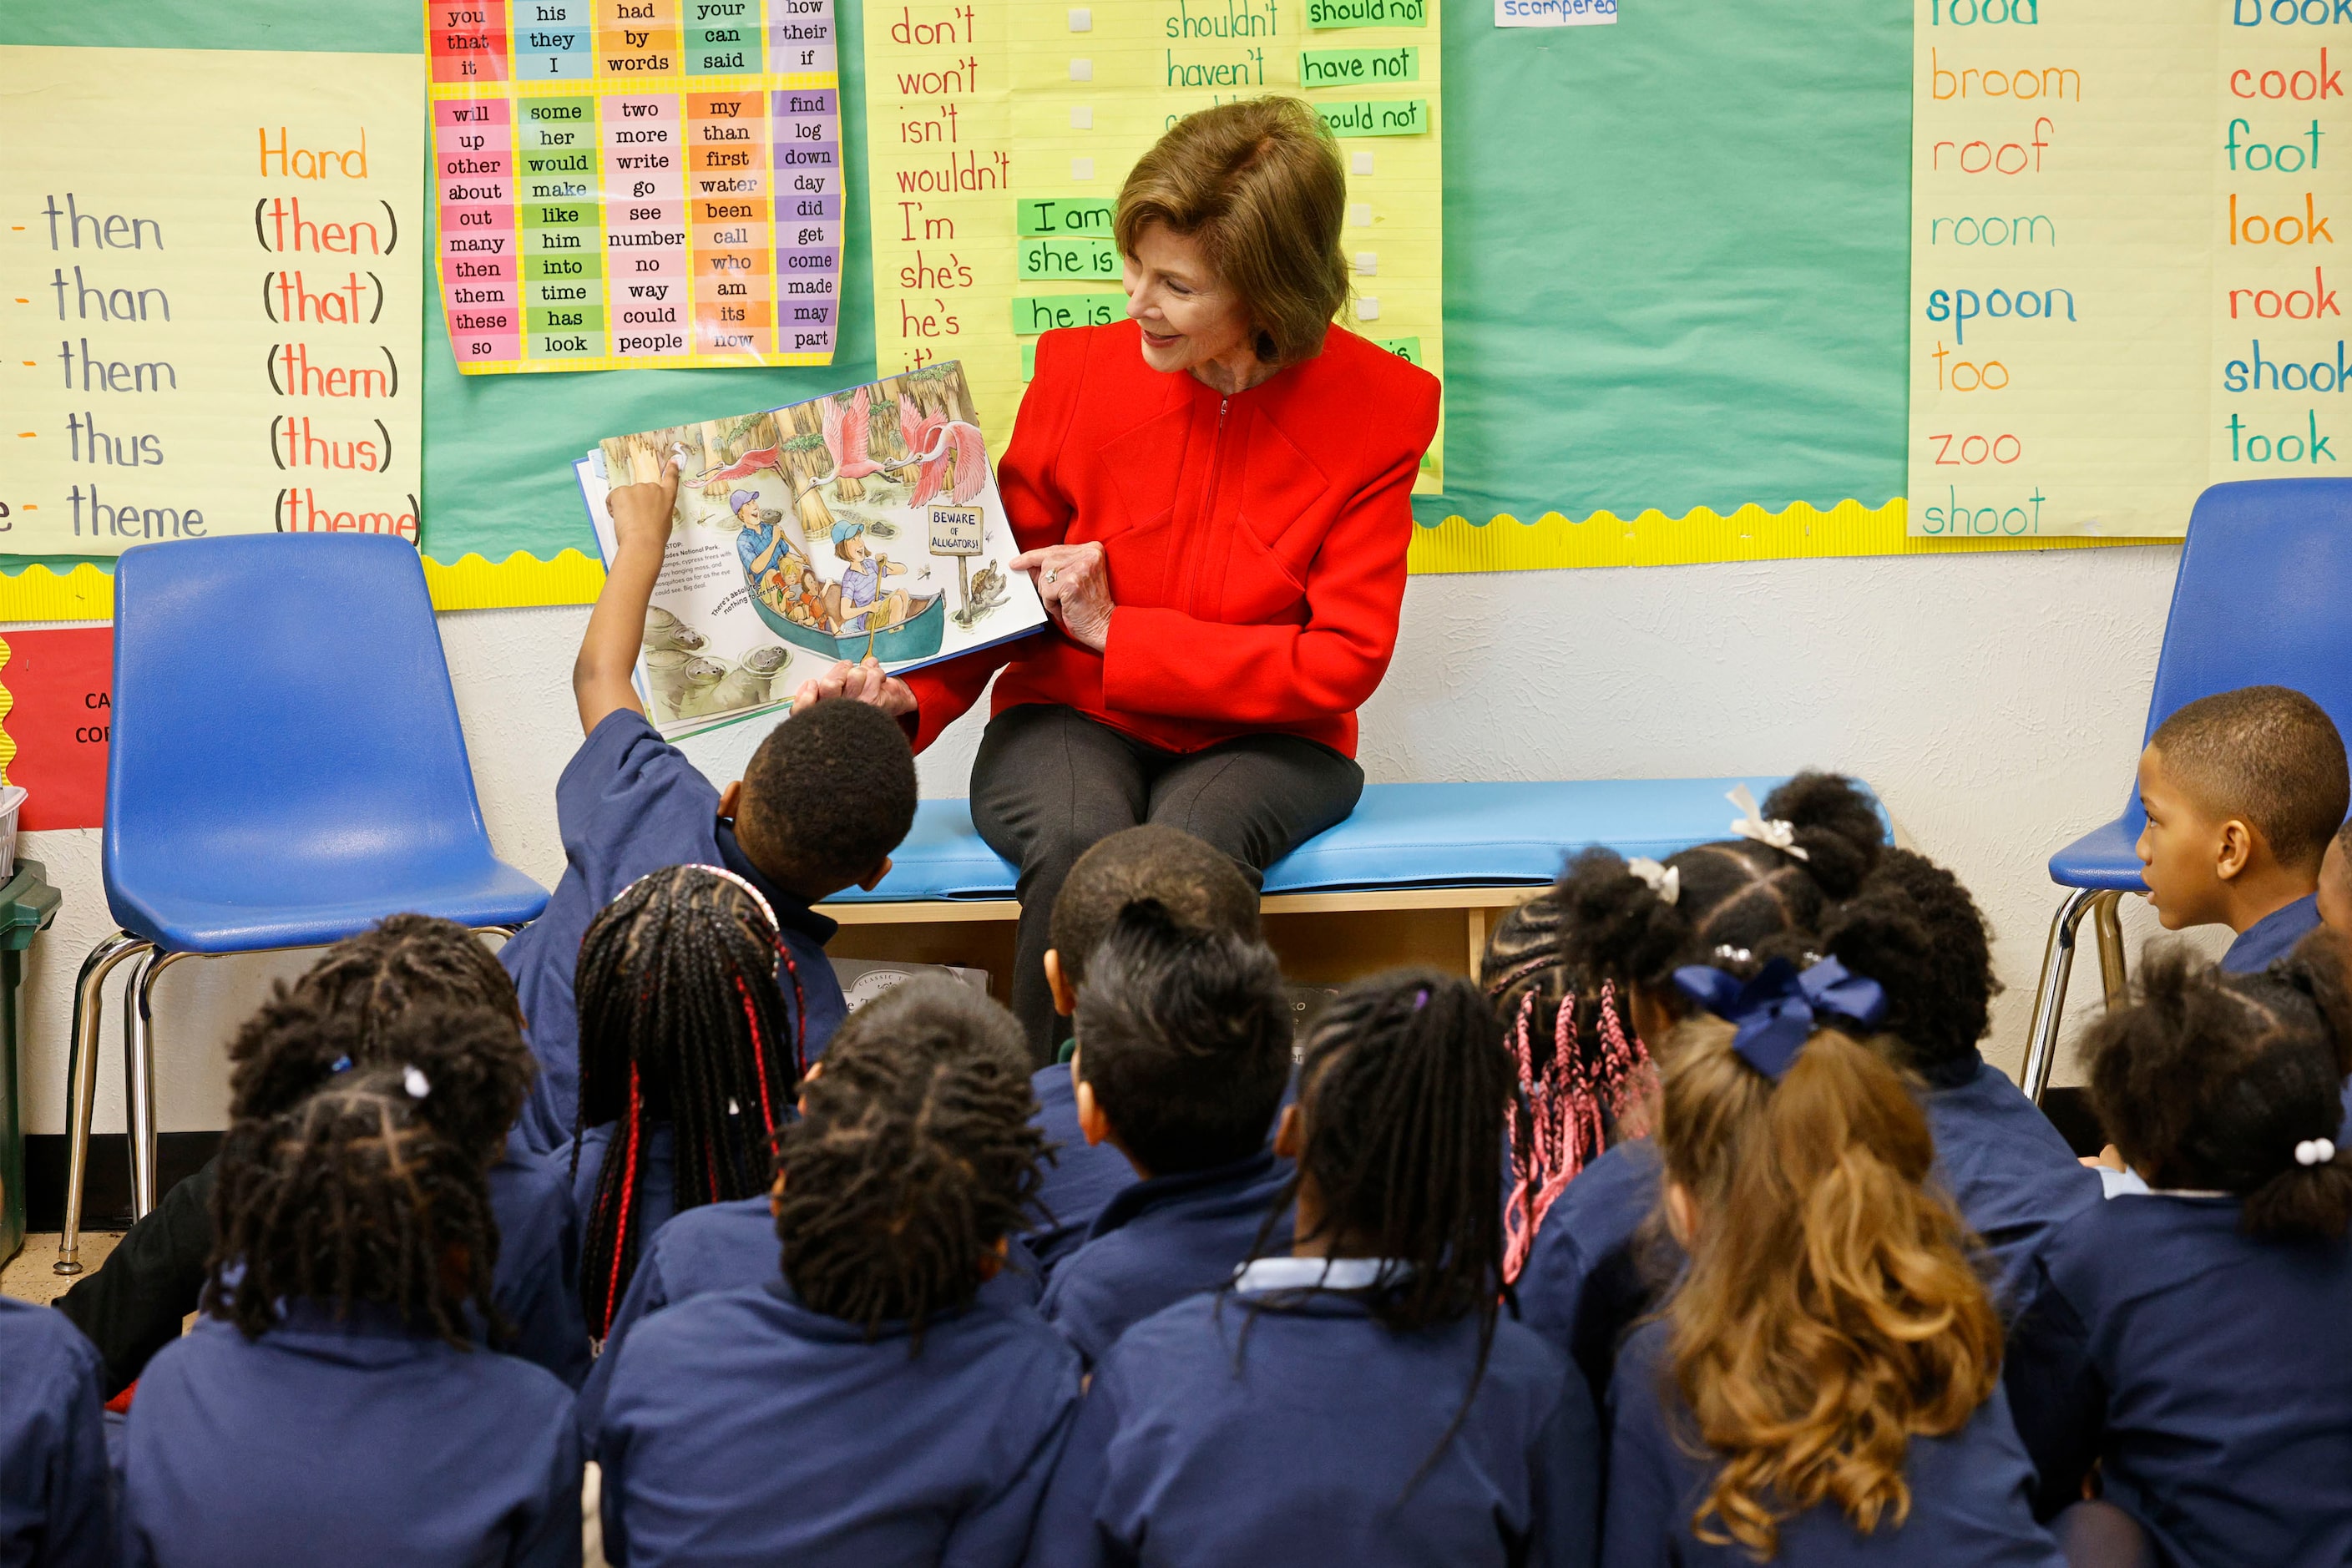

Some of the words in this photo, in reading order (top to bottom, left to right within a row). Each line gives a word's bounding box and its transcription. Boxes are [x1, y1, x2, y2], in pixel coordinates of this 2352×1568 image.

[536, 6, 566, 21] his
[617, 3, 655, 18] had
[697, 3, 746, 20] your
[786, 0, 823, 13] how
[1311, 0, 1384, 23] should
[1505, 0, 1617, 23] scampered
[2233, 0, 2352, 27] book
[448, 12, 485, 29] you
[892, 5, 974, 44] don't
[1166, 0, 1277, 38] shouldn't
[624, 30, 650, 48] by
[705, 28, 741, 43] can
[782, 24, 827, 40] their
[447, 31, 492, 53] that
[529, 32, 575, 50] they
[549, 58, 559, 73] I
[607, 54, 669, 71] words
[704, 53, 745, 68] said
[801, 50, 815, 65] if
[1303, 53, 1364, 80] have
[1373, 48, 1409, 77] not
[462, 61, 477, 75] it
[898, 56, 978, 94] won't
[1167, 47, 1263, 87] haven't
[1932, 47, 2080, 102] broom
[2231, 47, 2344, 100] cook
[622, 103, 658, 117] two
[710, 102, 741, 118] my
[790, 96, 826, 112] find
[453, 106, 489, 122] will
[531, 107, 581, 119] some
[1383, 101, 1417, 128] not
[703, 125, 751, 140] than
[796, 123, 822, 140] log
[900, 104, 958, 144] isn't
[459, 135, 484, 150] up
[539, 130, 574, 145] her
[615, 130, 667, 143] more
[2224, 118, 2324, 172] foot
[259, 127, 367, 180] Hard
[1934, 117, 2054, 175] roof
[528, 154, 589, 172] would
[616, 154, 669, 169] write
[706, 151, 749, 166] first
[785, 149, 832, 164] down
[448, 159, 501, 175] other
[897, 149, 1009, 193] wouldn't
[449, 184, 502, 200] about
[532, 181, 586, 197] make
[633, 180, 655, 198] go
[699, 177, 757, 192] water
[794, 175, 826, 193] day
[542, 207, 579, 223] like
[630, 208, 661, 220] see
[706, 203, 753, 218] been
[797, 200, 823, 216] did
[1034, 202, 1055, 231] I
[1065, 209, 1113, 229] am
[41, 193, 164, 250] then
[255, 197, 397, 255] (then)
[460, 210, 492, 225] out
[898, 202, 953, 241] I'm
[2230, 193, 2334, 245] look
[608, 230, 685, 246] number
[714, 228, 748, 244] call
[798, 227, 824, 245] get
[1932, 215, 2055, 246] room
[450, 239, 505, 254] many
[542, 234, 581, 249] him
[711, 254, 751, 270] who
[788, 255, 832, 268] come
[1028, 241, 1084, 272] she
[1092, 241, 1113, 272] is
[455, 262, 501, 278] then
[543, 259, 582, 275] into
[635, 260, 660, 271] no
[901, 250, 973, 289] she's
[50, 266, 169, 321] than
[541, 286, 586, 300] time
[628, 286, 669, 301] way
[717, 283, 747, 296] am
[788, 278, 832, 294] made
[2229, 266, 2340, 319] rook
[264, 271, 383, 324] (that)
[454, 288, 505, 303] them
[547, 311, 583, 326] has
[624, 307, 677, 323] could
[721, 306, 745, 321] its
[794, 307, 829, 323] may
[901, 299, 959, 337] he's
[1032, 299, 1074, 328] he
[1087, 299, 1111, 326] is
[1925, 289, 2076, 345] spoon
[454, 314, 507, 331] these
[473, 342, 492, 355] so
[544, 336, 588, 352] look
[619, 333, 682, 352] people
[714, 335, 754, 347] now
[795, 331, 832, 351] part
[58, 338, 176, 392] them
[267, 343, 397, 398] (them)
[1932, 341, 2009, 392] too
[2224, 339, 2352, 392] shook
[66, 412, 163, 466] thus
[271, 415, 392, 473] (thus)
[2224, 409, 2336, 464] took
[1929, 434, 2021, 465] zoo
[67, 483, 207, 539] theme
[276, 488, 421, 547] (theme)
[1923, 484, 2046, 535] shoot
[933, 512, 975, 525] BEWARE
[950, 528, 959, 536] OF
[680, 547, 704, 555] National
[932, 537, 979, 549] ALLIGATORS!
[711, 597, 730, 616] There's
[730, 583, 761, 599] absolutely
[724, 596, 747, 615] nothing
[85, 693, 110, 709] CA
